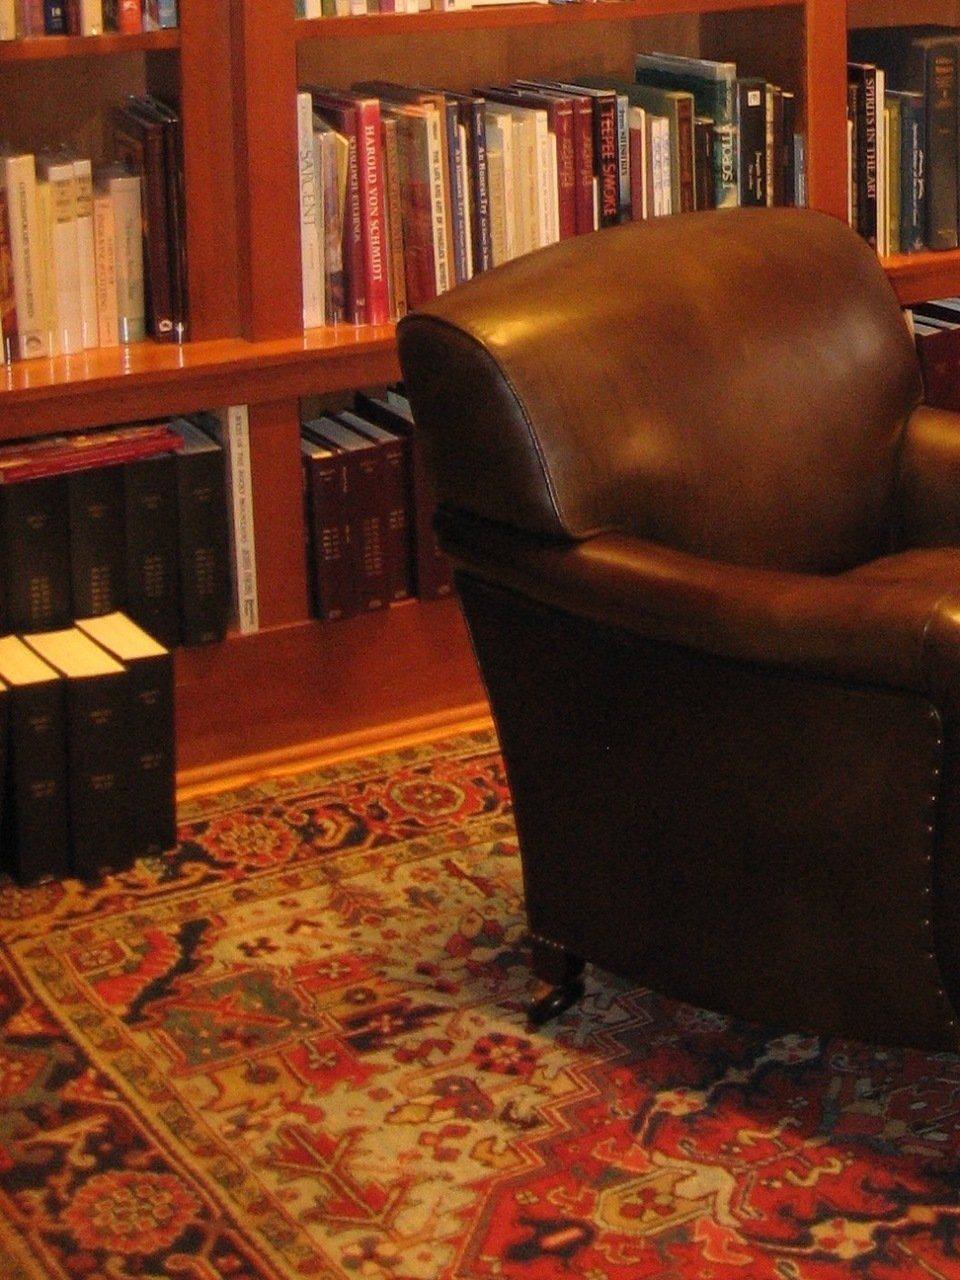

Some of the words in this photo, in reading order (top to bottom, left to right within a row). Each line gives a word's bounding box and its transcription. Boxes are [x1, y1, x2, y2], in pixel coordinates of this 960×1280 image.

[865, 79, 877, 126] SPIRITS
[599, 110, 615, 160] TEEPEE
[866, 127, 877, 143] IN
[364, 125, 377, 184] HAROLD
[477, 146, 485, 161] An
[866, 148, 877, 173] THE
[300, 150, 316, 227] SARGENT
[478, 162, 487, 197] Honest
[602, 163, 617, 217] SMOKE
[866, 173, 878, 200] ART
[367, 187, 379, 217] VON
[479, 199, 488, 215] Try
[369, 219, 382, 283] SCHMIDT
